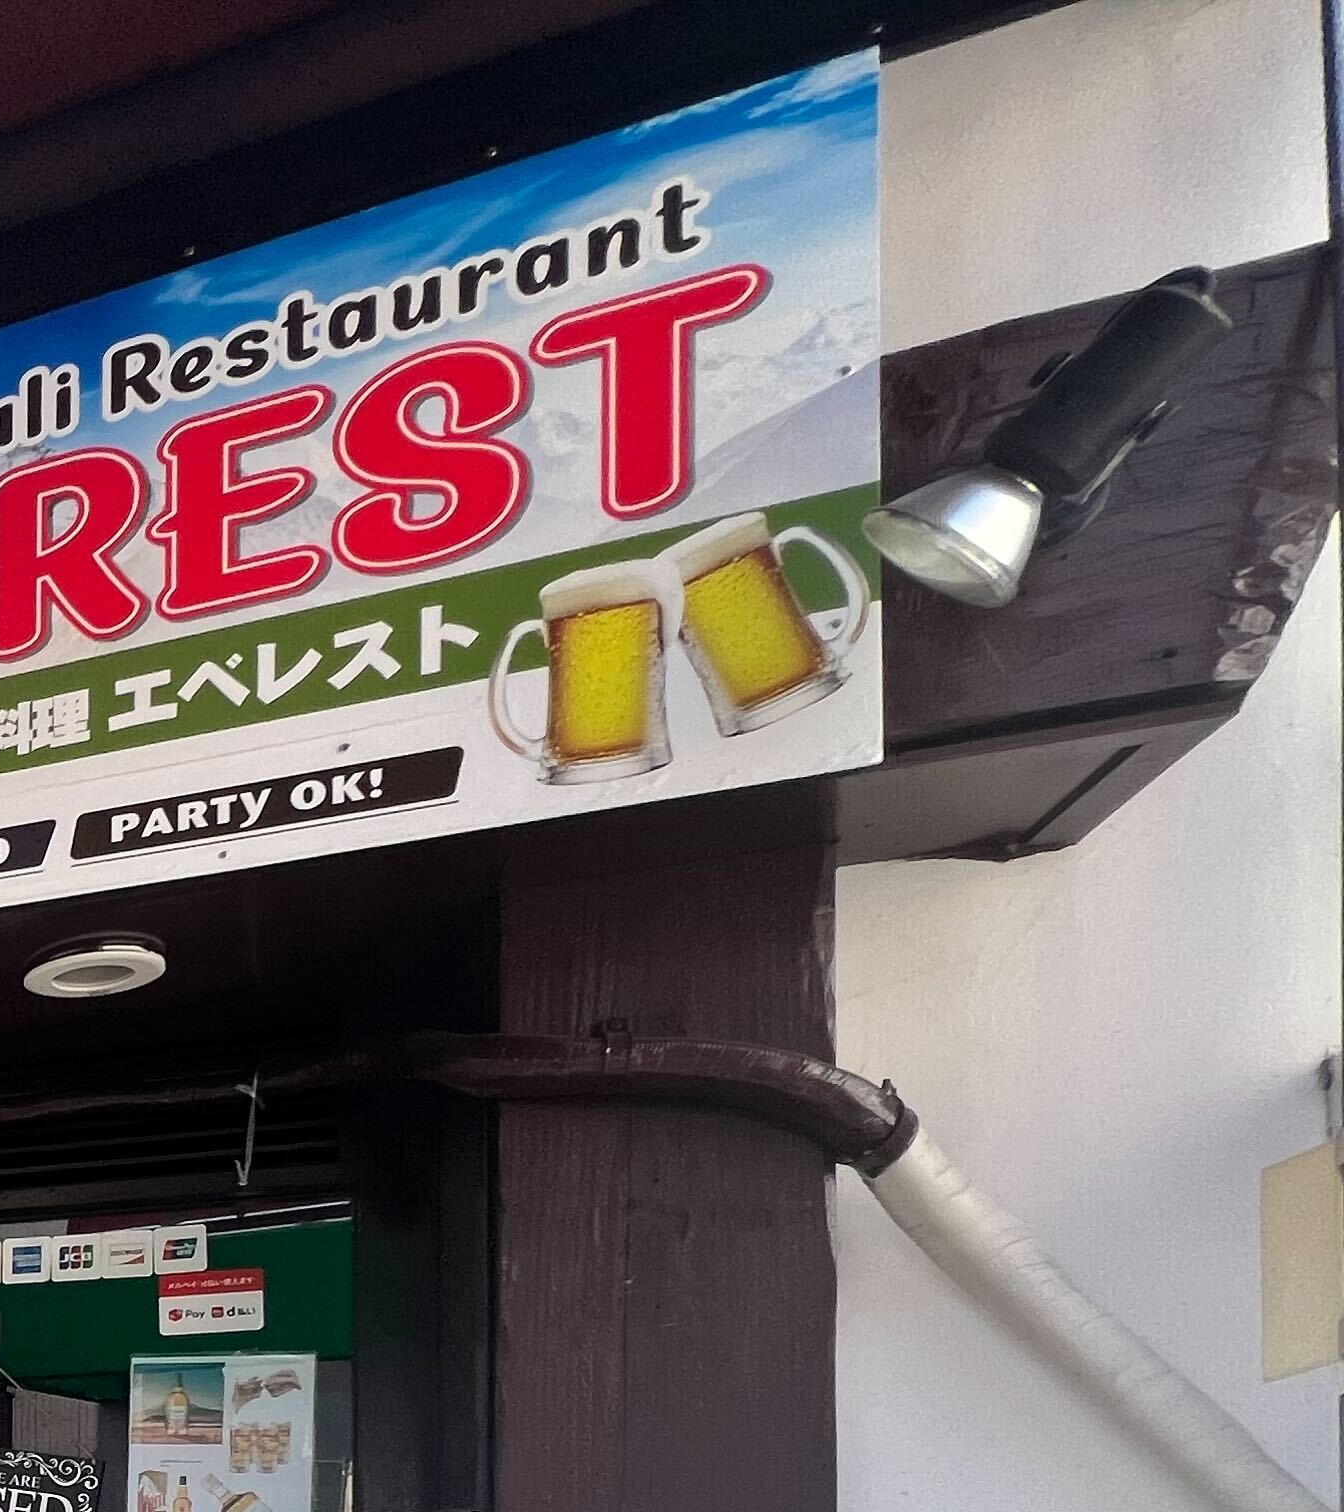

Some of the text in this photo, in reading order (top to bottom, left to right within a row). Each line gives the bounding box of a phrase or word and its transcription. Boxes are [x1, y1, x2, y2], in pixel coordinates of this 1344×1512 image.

[111, 184, 708, 414] Restaurant
[109, 605, 480, 734] エベレスト
[111, 768, 384, 844] PARTY OK!
[185, 1309, 206, 1318] Pay
[10, 1473, 41, 1490] ARE
